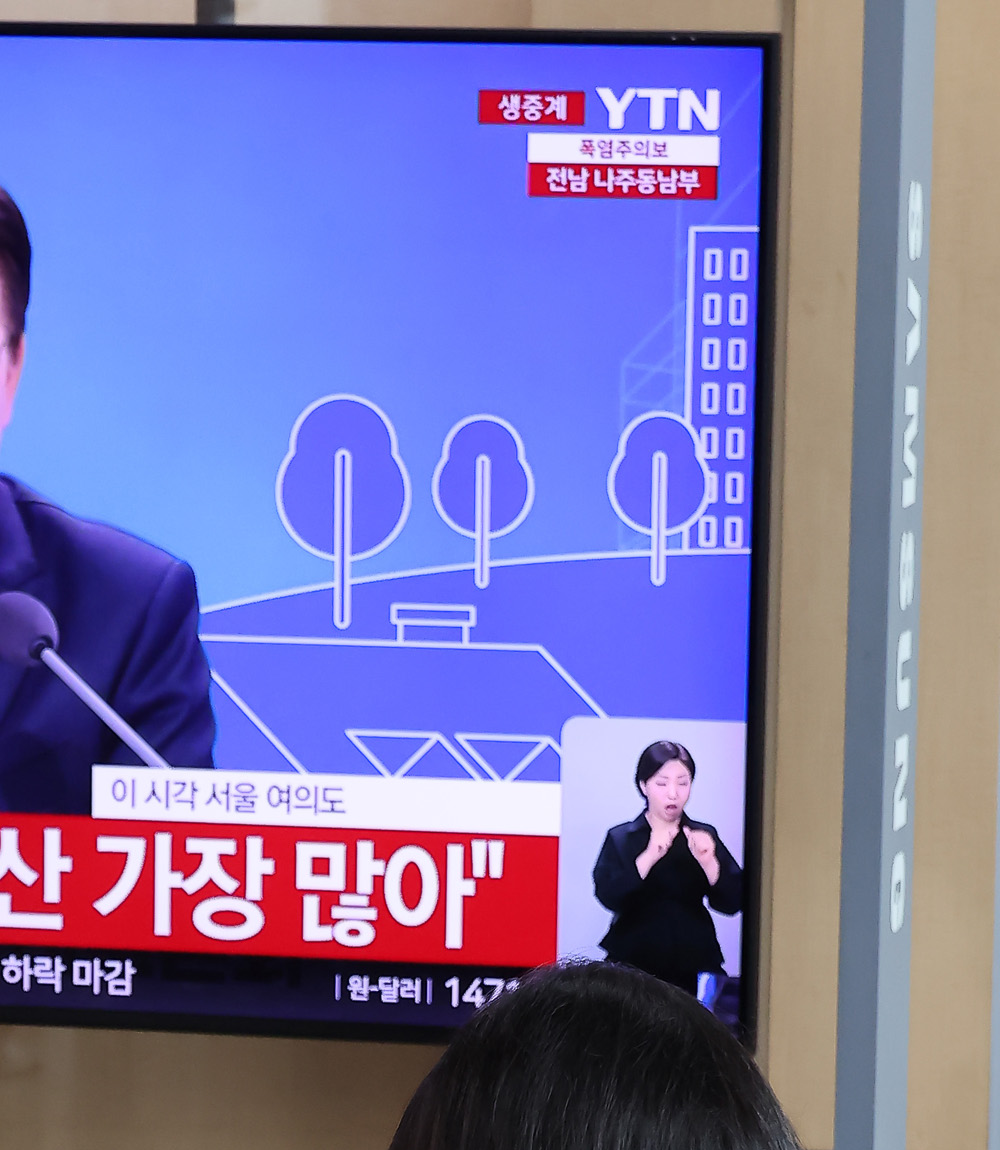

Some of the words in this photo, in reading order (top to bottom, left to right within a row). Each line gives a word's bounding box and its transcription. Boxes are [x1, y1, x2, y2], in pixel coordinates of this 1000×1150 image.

[498, 93, 567, 121] 생중계
[595, 87, 720, 131] YTN
[580, 139, 668, 159] 폭염주의보
[546, 167, 590, 192] 전남
[594, 168, 700, 195] 나주동남부
[888, 180, 923, 934] SAMSUNG
[111, 778, 137, 810] 이
[144, 779, 199, 811] 시각
[205, 782, 259, 814] 서울
[266, 784, 347, 816] 여의도
[92, 832, 275, 941] 가장
[295, 839, 505, 950] 많아"
[1, 953, 67, 995] 하락
[72, 957, 137, 997] 마감
[445, 976, 521, 1008] 147
